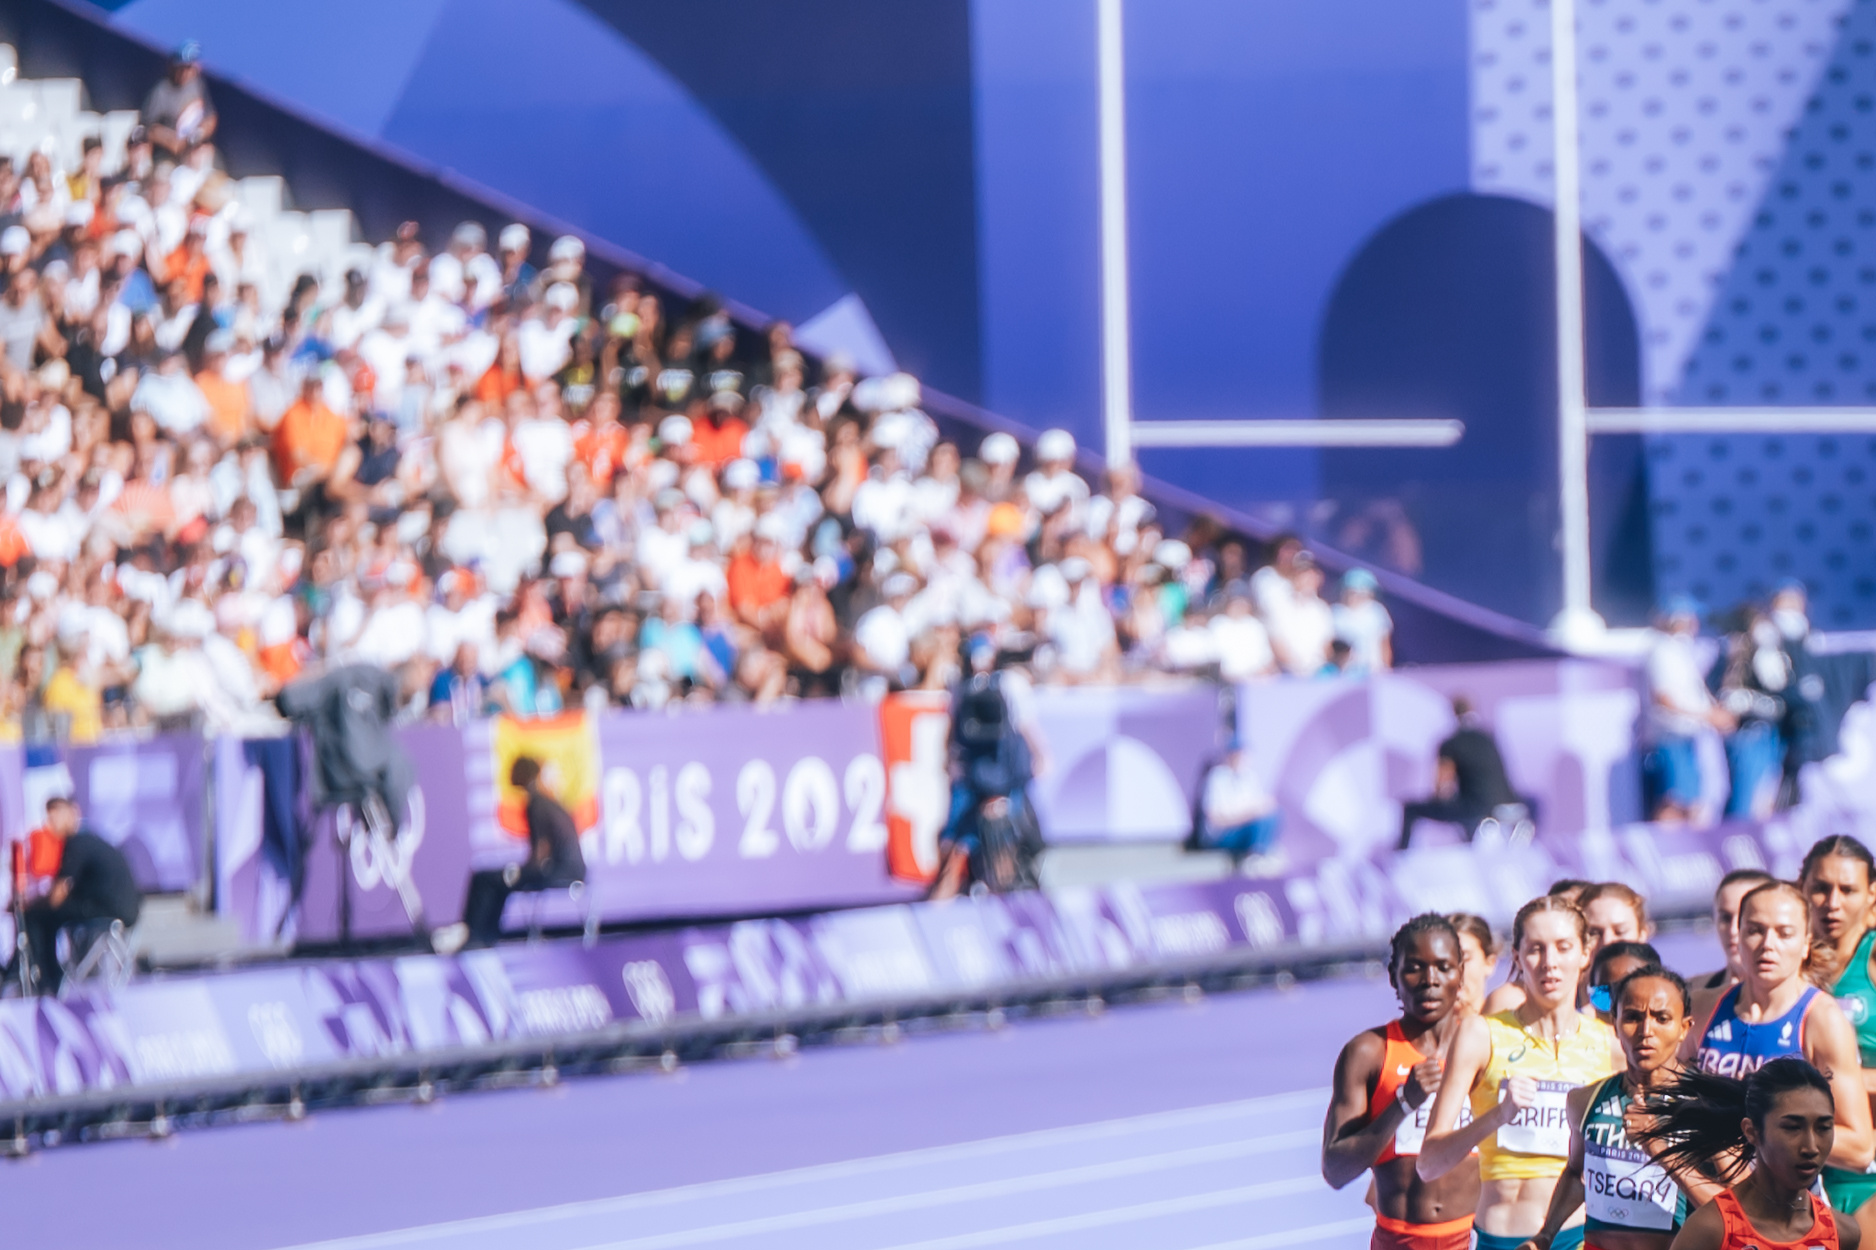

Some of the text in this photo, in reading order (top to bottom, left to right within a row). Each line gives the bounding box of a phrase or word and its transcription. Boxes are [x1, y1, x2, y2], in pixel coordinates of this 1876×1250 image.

[736, 753, 889, 860] 202
[1697, 1047, 1773, 1079] FRAN
[1508, 1105, 1568, 1129] GRIFF
[1588, 1169, 1671, 1202] TSEGAY
